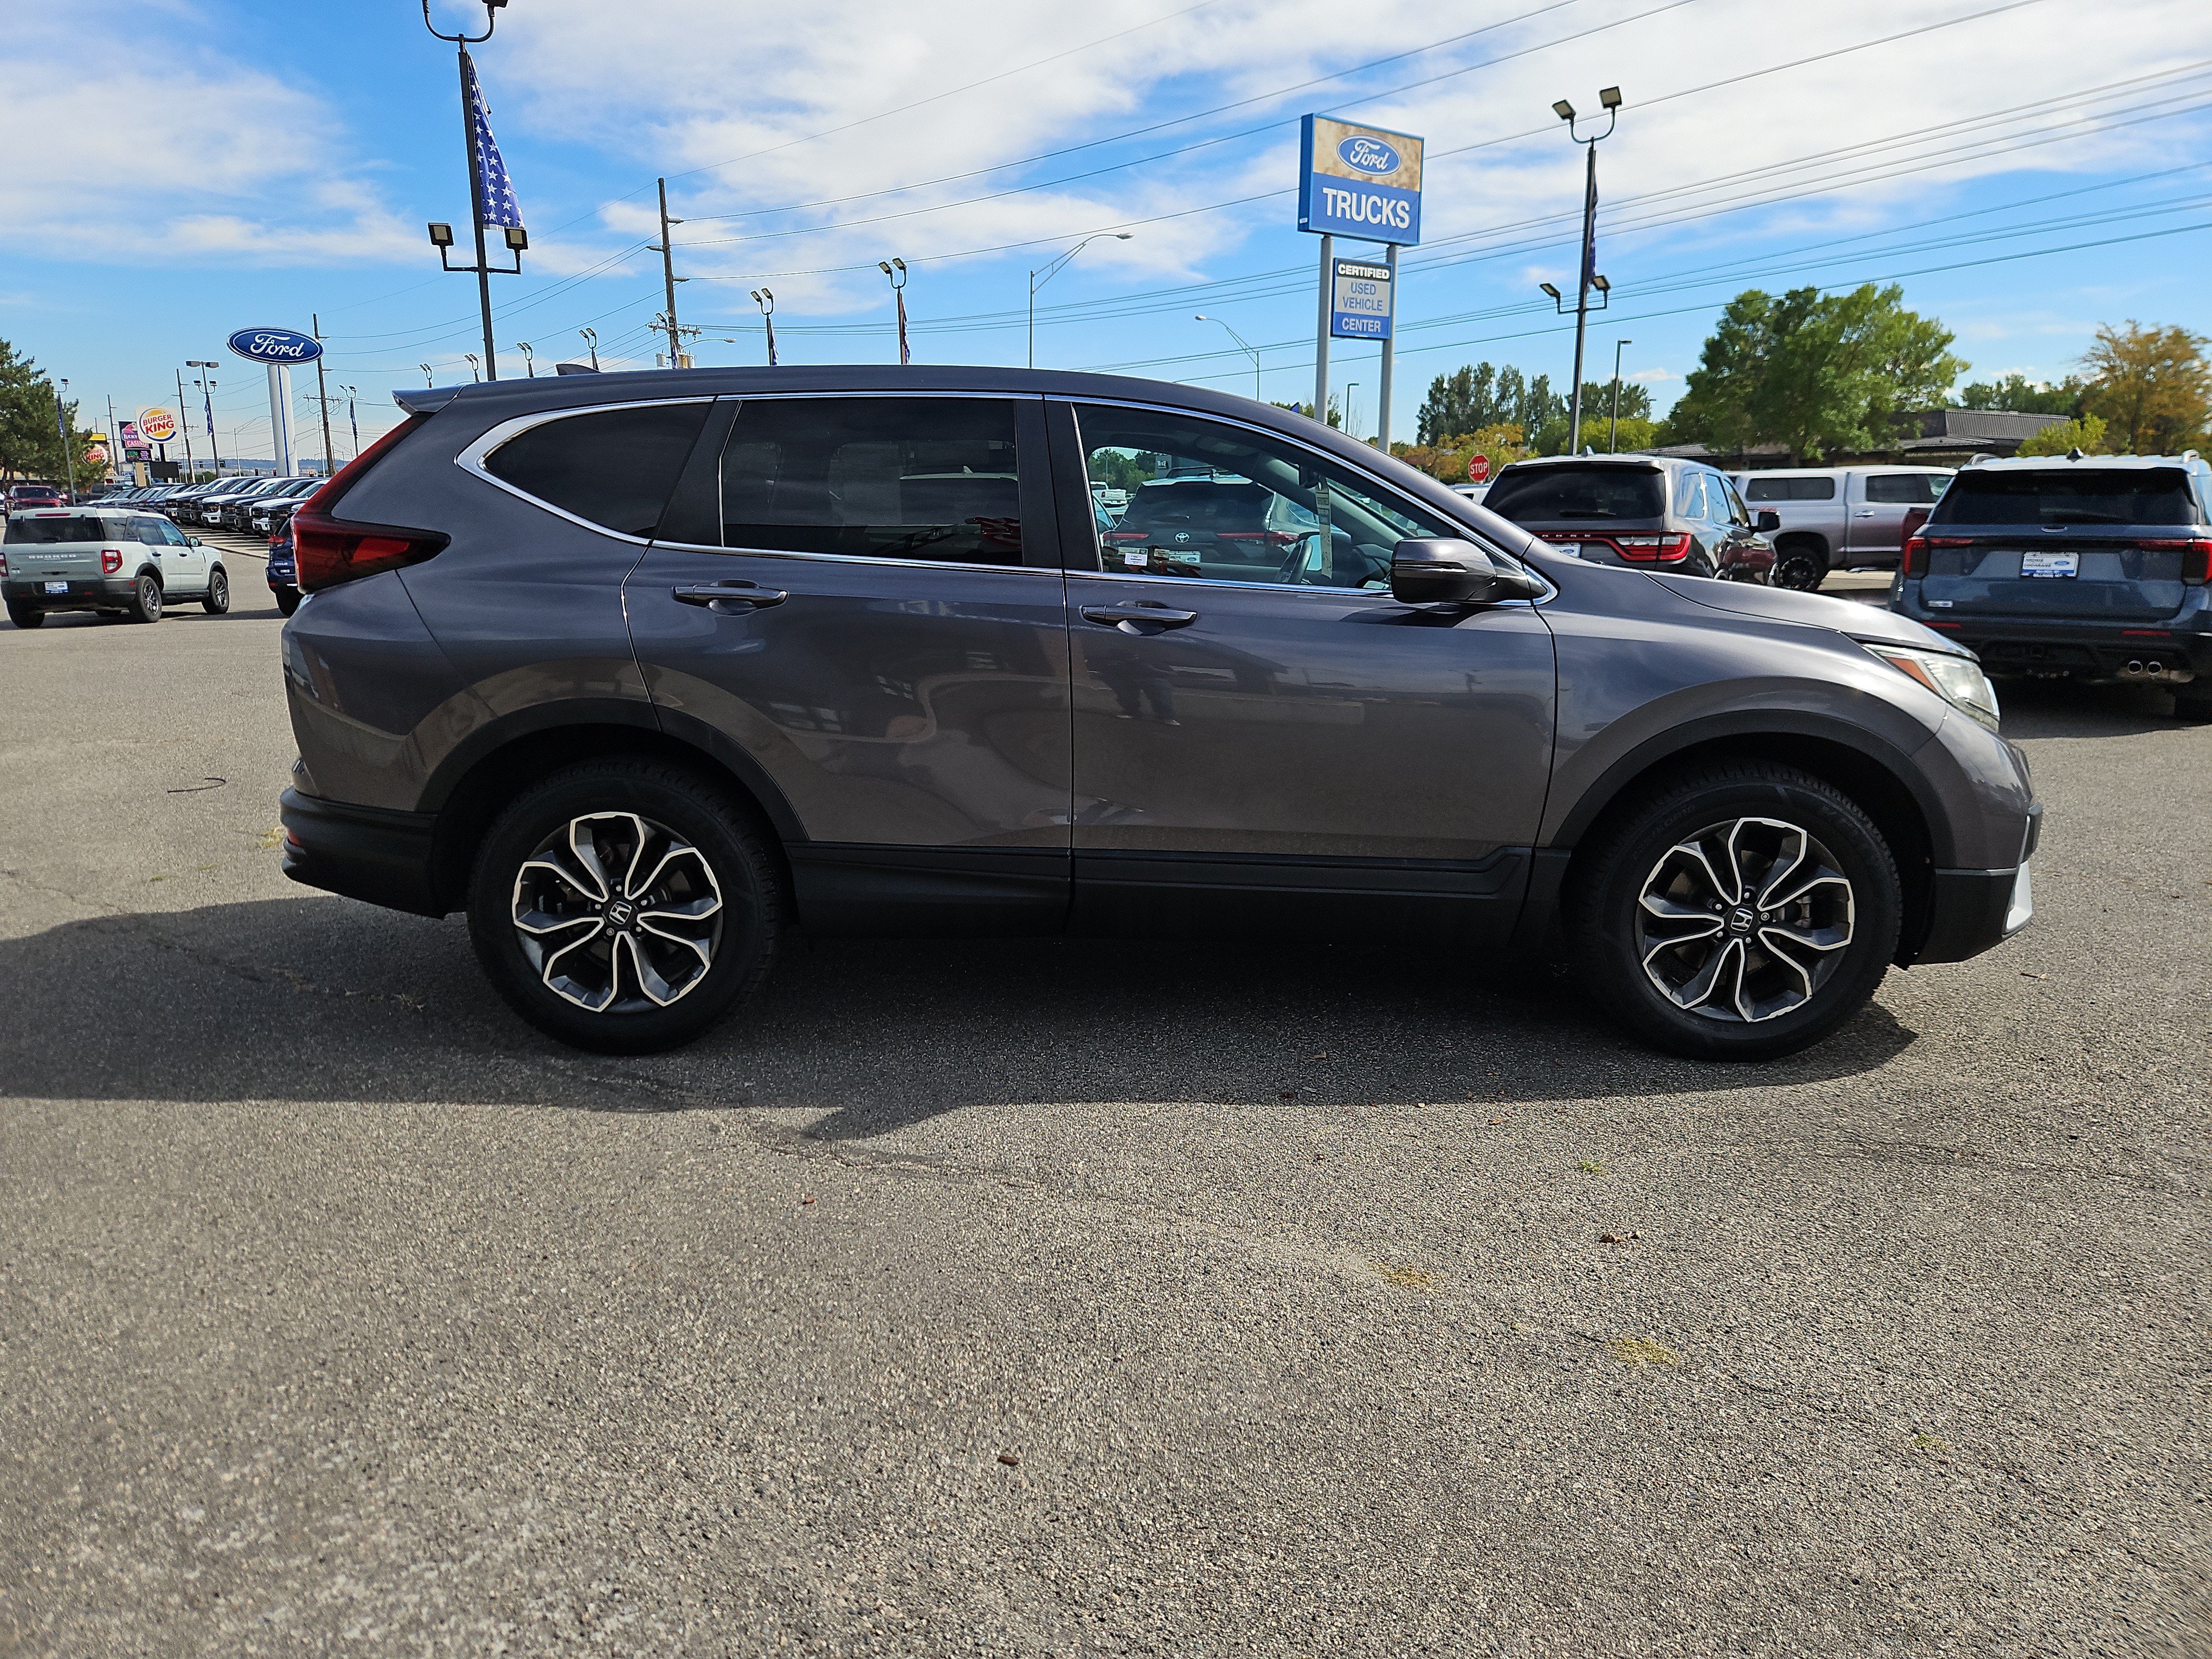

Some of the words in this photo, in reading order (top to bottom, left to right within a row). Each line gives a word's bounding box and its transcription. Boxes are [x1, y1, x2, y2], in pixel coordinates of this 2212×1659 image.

[1350, 140, 1390, 170] Ford
[1322, 187, 1410, 229] TRUCKS
[1338, 264, 1390, 279] CERTIFIED
[1351, 282, 1377, 295] USED
[1342, 296, 1383, 312] VEHICLE
[1342, 318, 1381, 333] CENTER
[250, 333, 305, 357] Ford
[143, 414, 172, 427] BURGER
[145, 420, 175, 435] KING
[86, 453, 105, 461] KING
[1470, 462, 1488, 475] STOP
